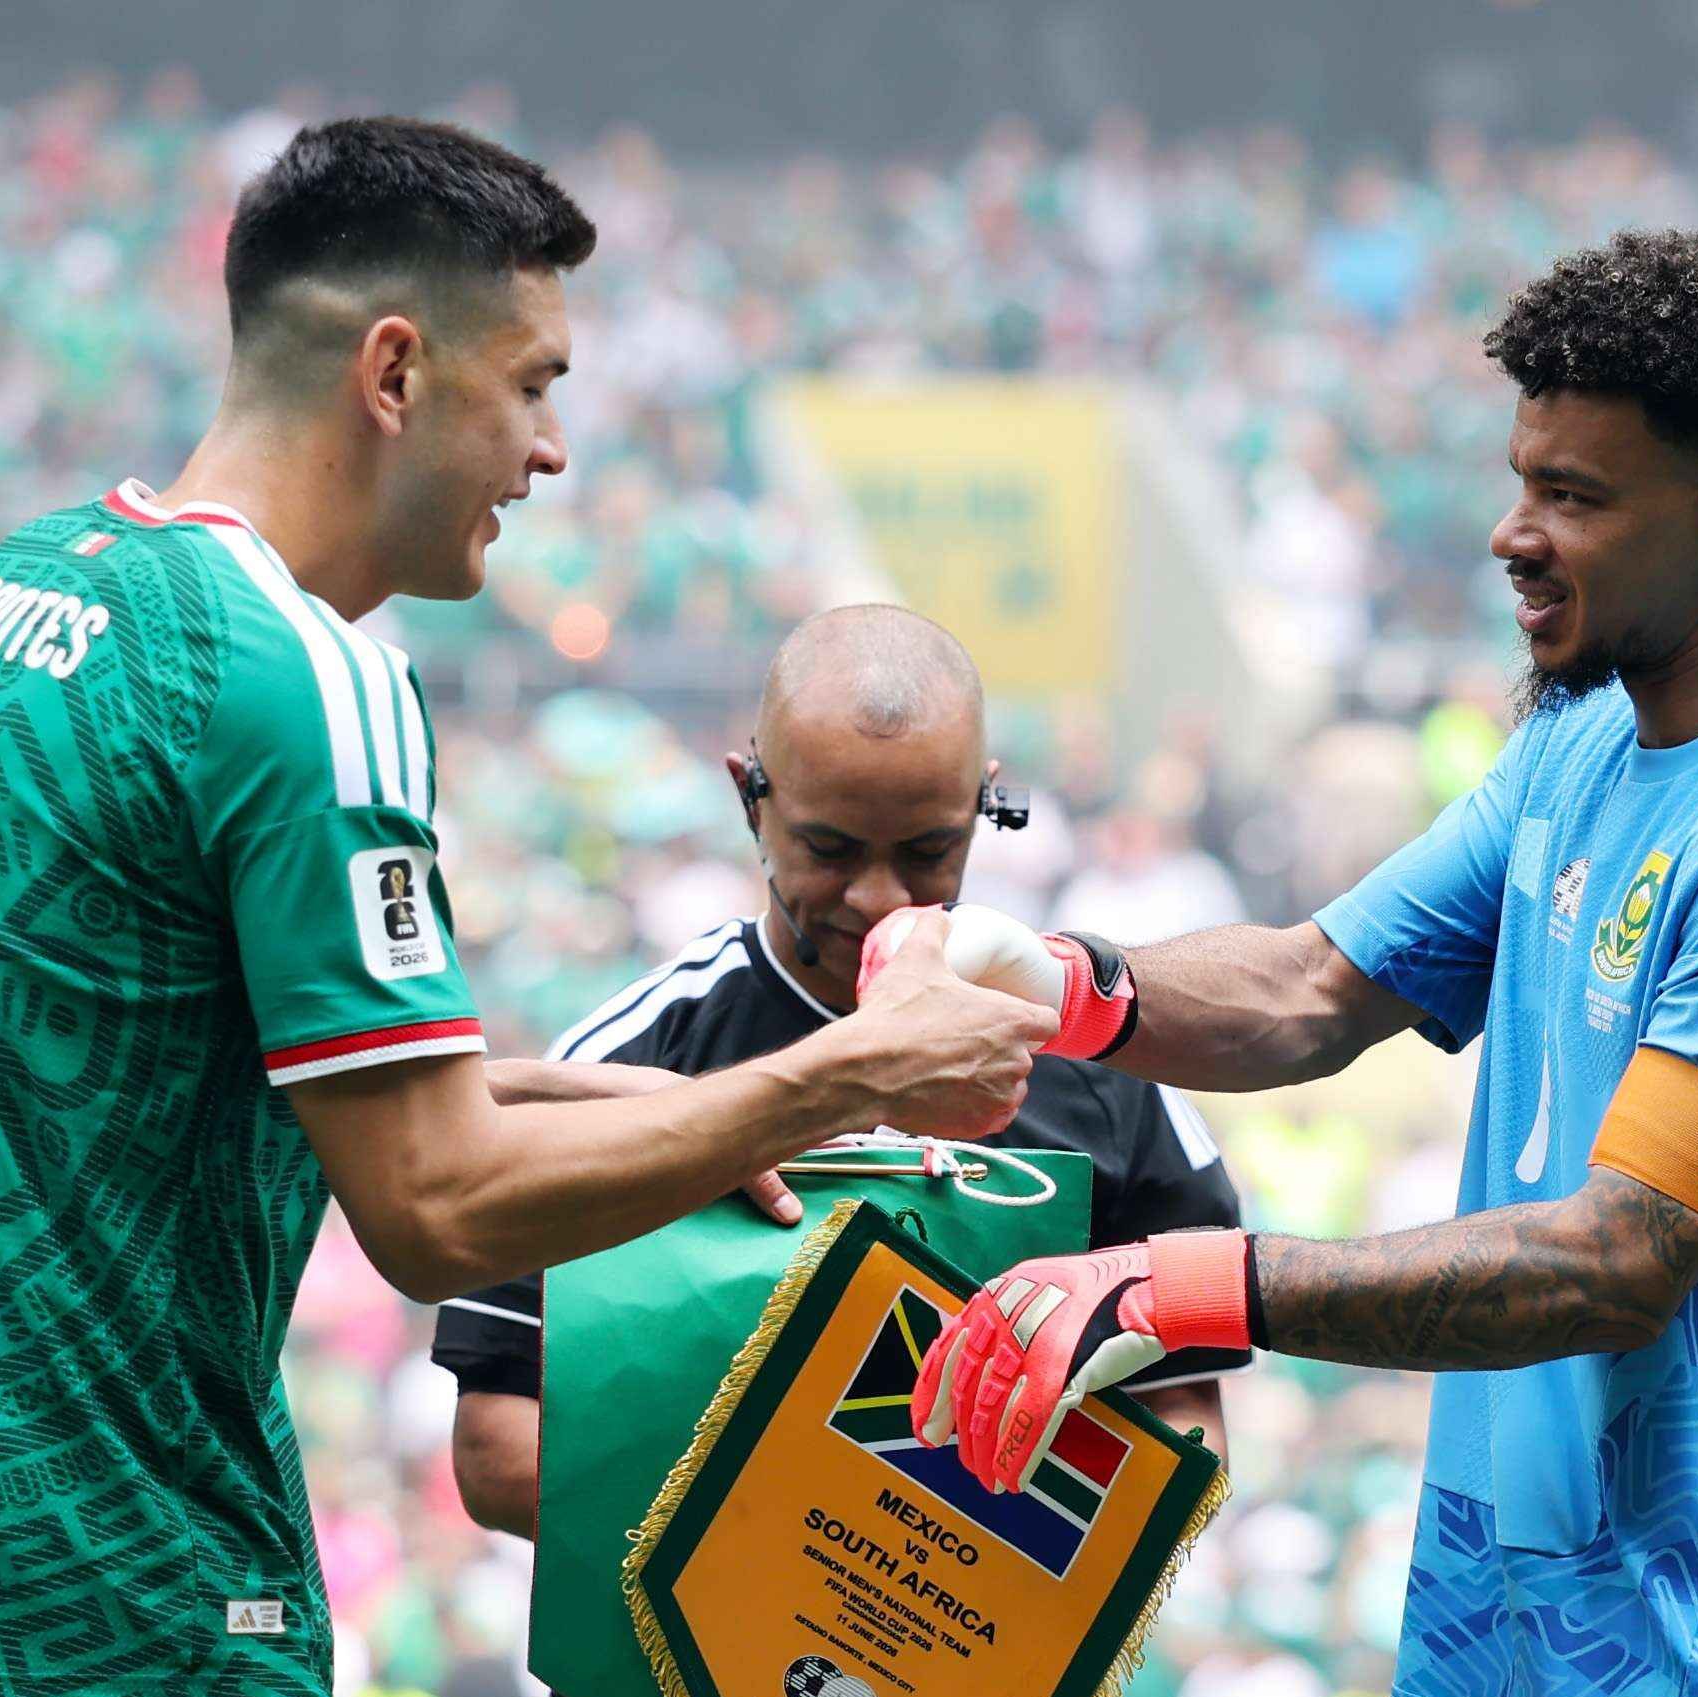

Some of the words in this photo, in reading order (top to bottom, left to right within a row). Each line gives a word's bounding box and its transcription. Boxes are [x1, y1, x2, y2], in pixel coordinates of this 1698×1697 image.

[875, 1488, 979, 1565] MEXICO
[905, 1539, 929, 1564] VS
[803, 1545, 847, 1577] SENIOR
[847, 1572, 883, 1600] MEN'S
[884, 1595, 937, 1637] NATIONAL
[939, 1632, 971, 1658] TEAM
[804, 1508, 899, 1577] SOUTH
[898, 1571, 996, 1645] AFRICA
[825, 1578, 847, 1597] FIFA
[848, 1592, 886, 1620] WORLD
[887, 1618, 909, 1636] CUP
[836, 1613, 849, 1625] 11
[848, 1622, 876, 1643] JUNE
[875, 1639, 899, 1657] 2026
[897, 1679, 916, 1693] CITY
